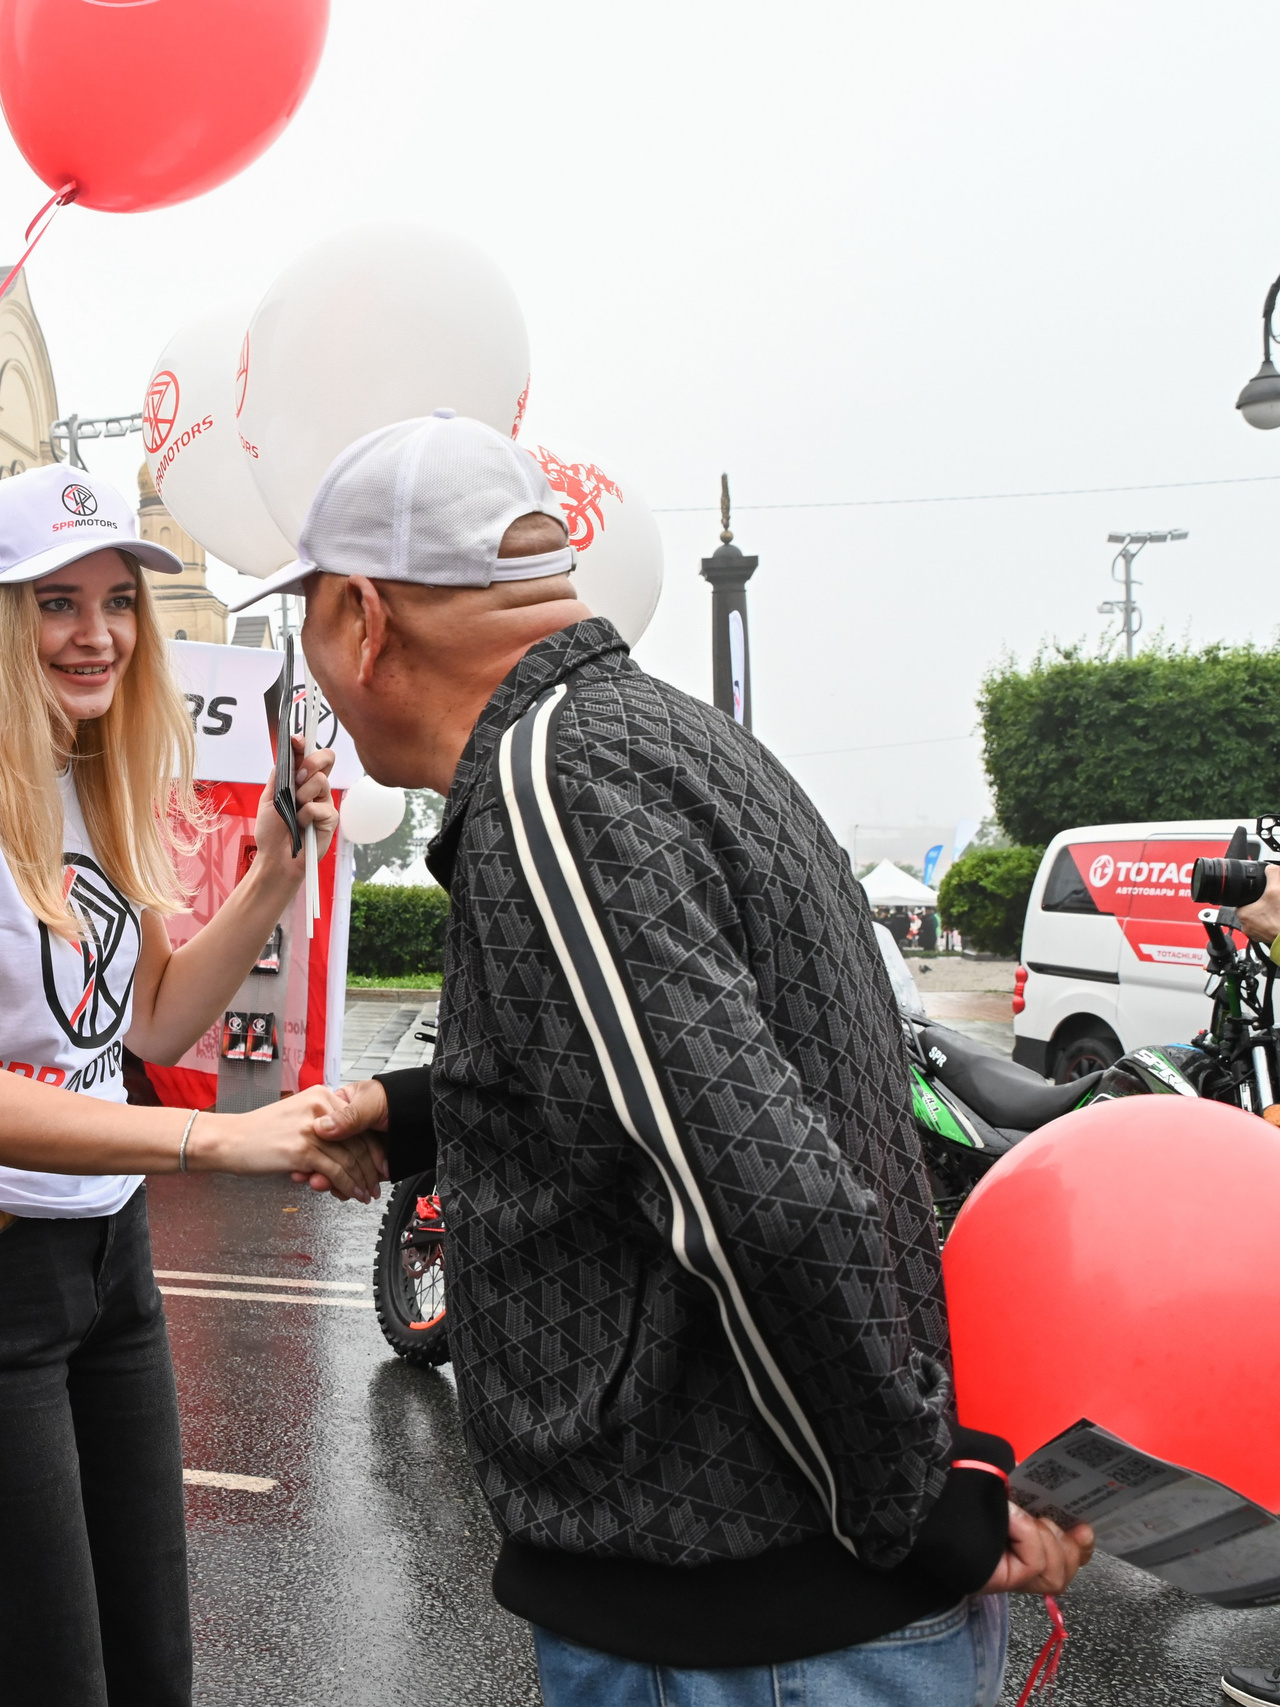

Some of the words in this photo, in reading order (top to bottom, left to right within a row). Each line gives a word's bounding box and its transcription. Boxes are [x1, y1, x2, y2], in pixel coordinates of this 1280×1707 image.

[52, 518, 118, 532] SPRMOTORS
[1115, 887, 1175, 897] АВТОТОВАРЫ
[1157, 950, 1203, 961] TOTACHI.RU
[929, 1046, 947, 1068] SPR
[1133, 1049, 1184, 1089] SPR
